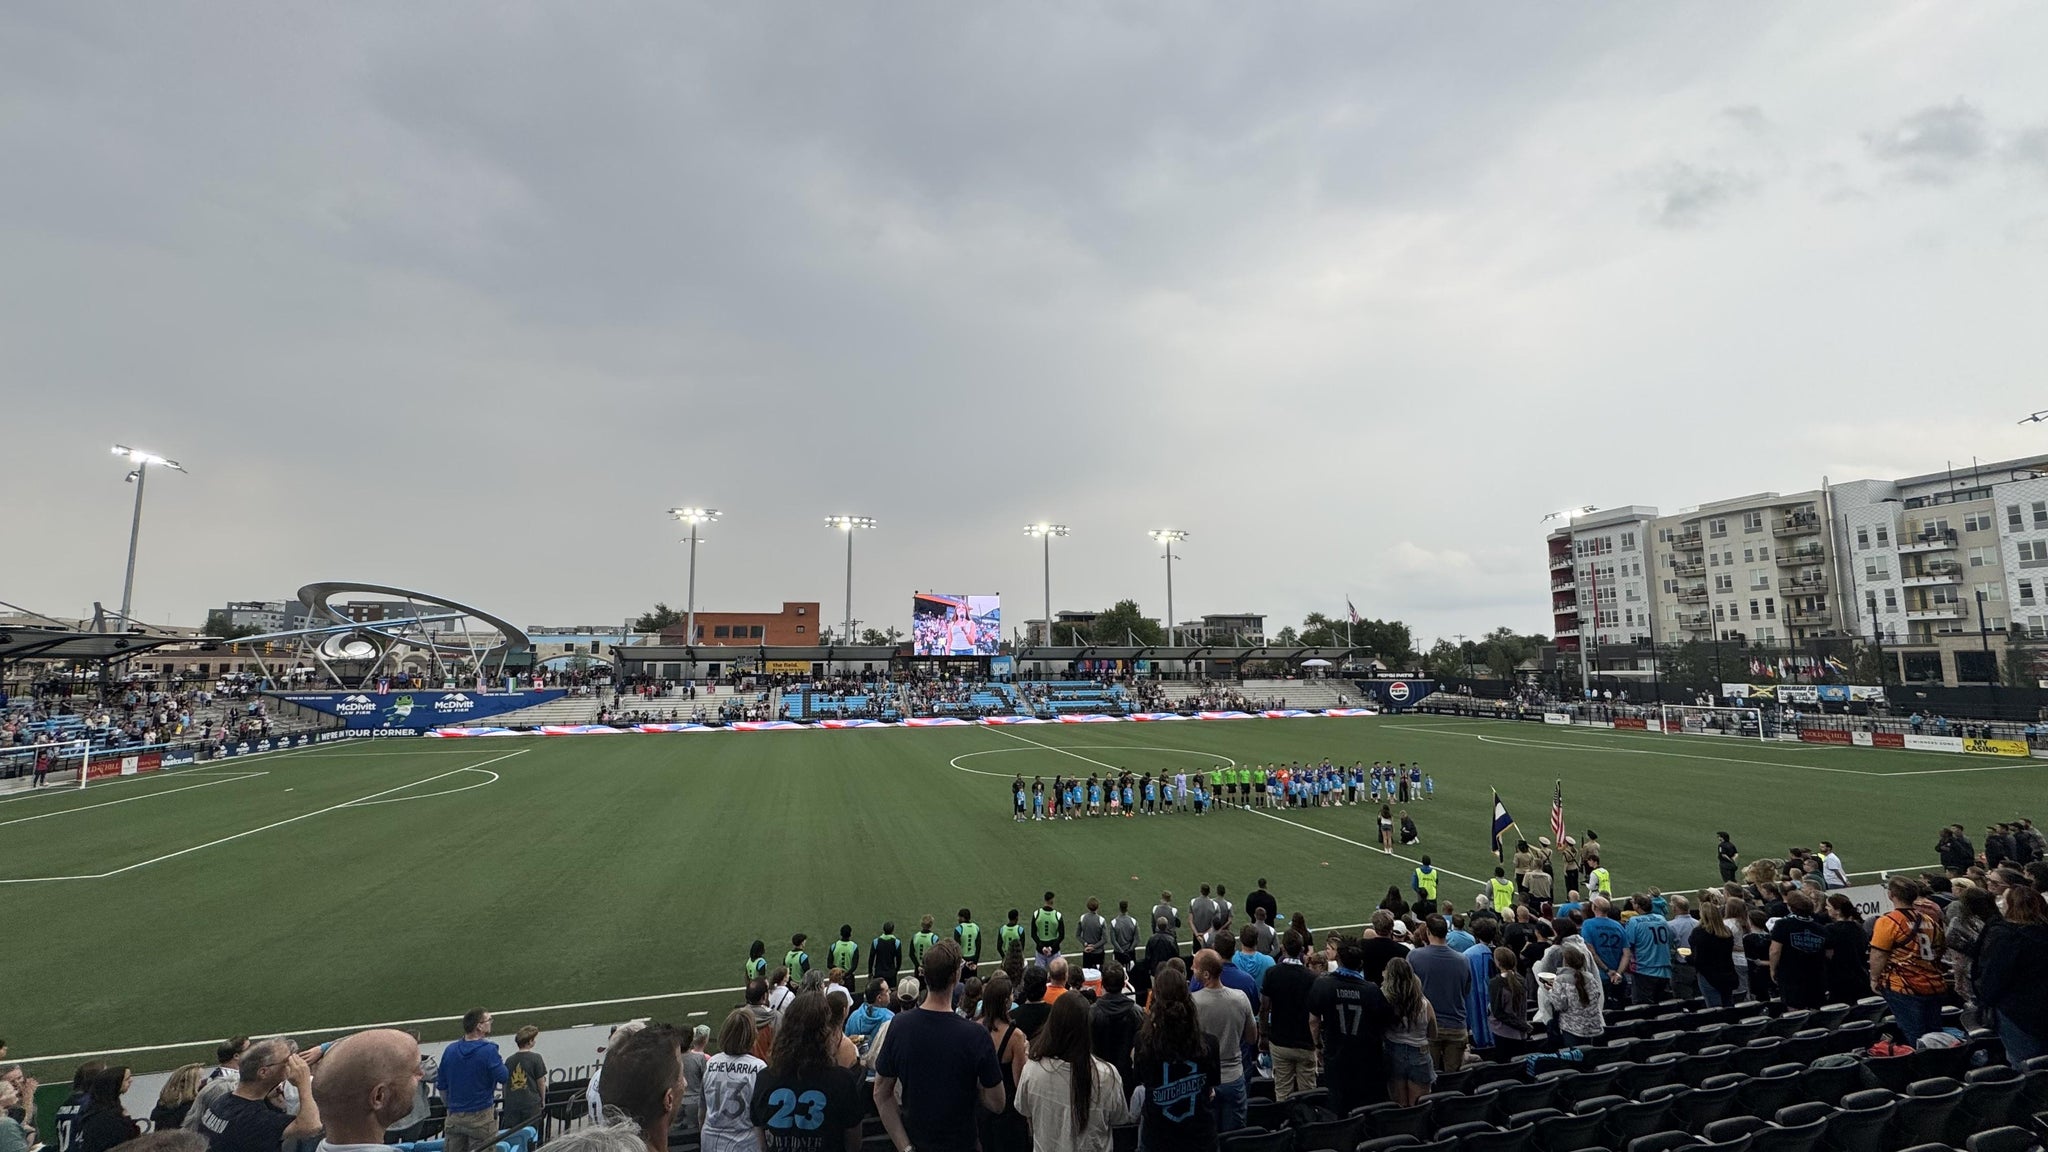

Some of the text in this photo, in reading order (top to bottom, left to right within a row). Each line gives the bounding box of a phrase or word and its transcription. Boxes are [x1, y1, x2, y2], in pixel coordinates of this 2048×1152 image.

[336, 703, 376, 711] McDivitt
[434, 700, 475, 709] McDivitt
[321, 729, 418, 741] WE'RE IN YOUR CORNER.
[1803, 731, 1822, 739] GOLD
[1965, 744, 1999, 753] CASINO
[1599, 932, 1620, 949] 22
[1648, 925, 1668, 945] 10
[1335, 1003, 1362, 1036] 17
[708, 1061, 759, 1074] ECHEVARRIA
[711, 1076, 749, 1119] 13
[767, 1088, 827, 1130] 23
